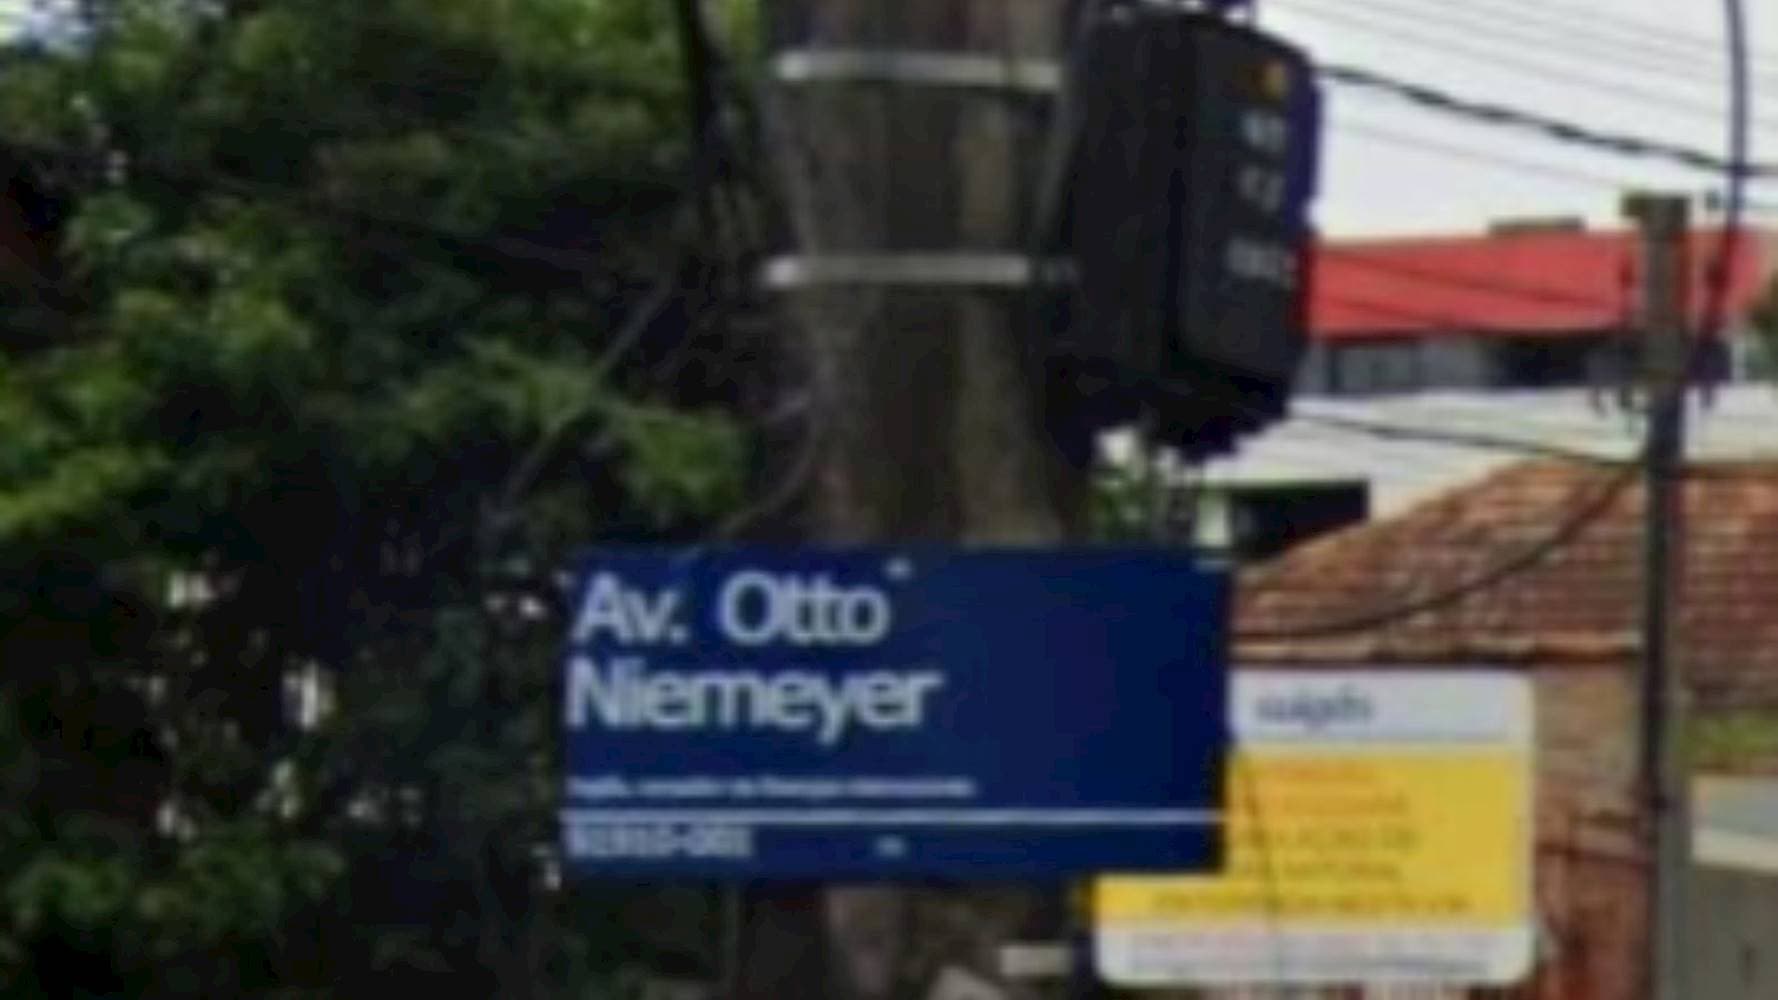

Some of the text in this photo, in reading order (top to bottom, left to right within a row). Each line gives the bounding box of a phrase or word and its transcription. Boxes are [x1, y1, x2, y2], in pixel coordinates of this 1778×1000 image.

[574, 570, 891, 645] Av. Otto
[566, 657, 944, 745] Niemeyer
